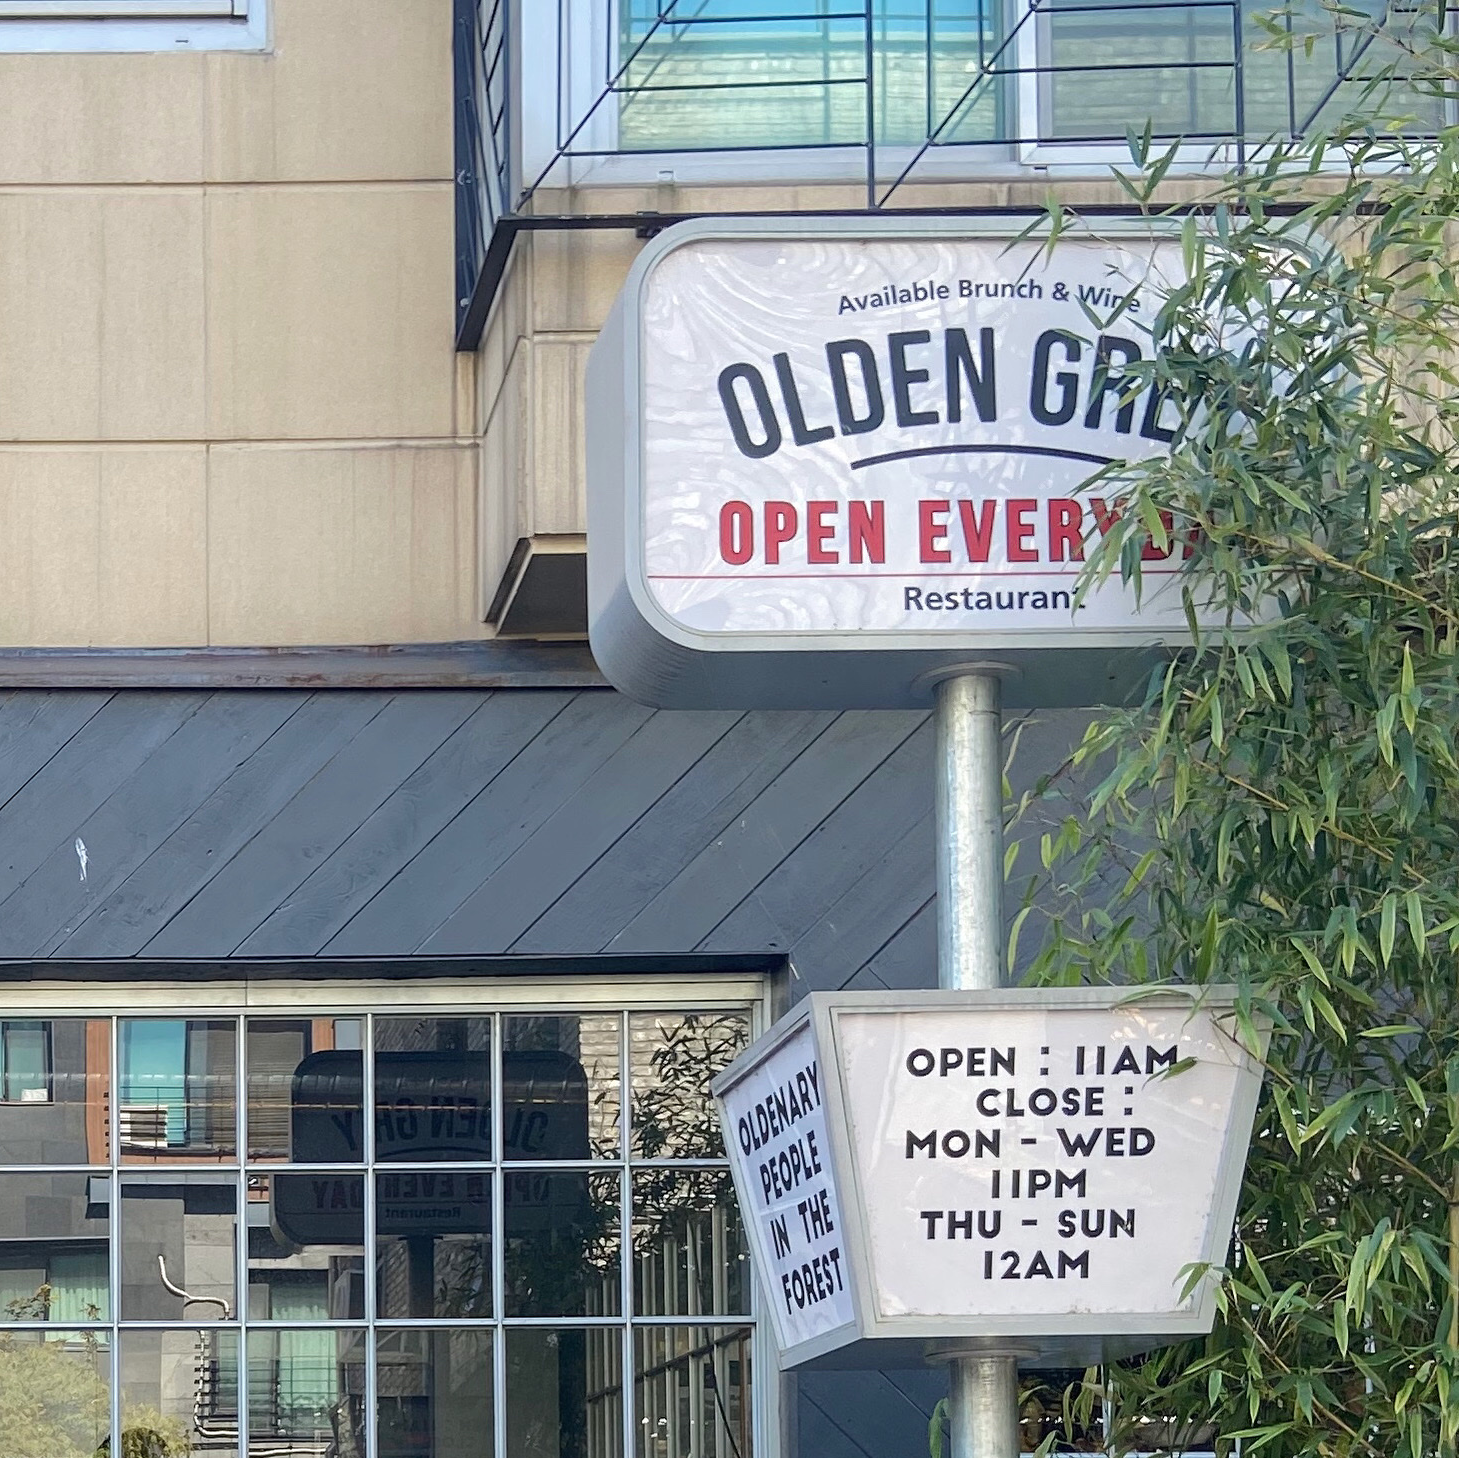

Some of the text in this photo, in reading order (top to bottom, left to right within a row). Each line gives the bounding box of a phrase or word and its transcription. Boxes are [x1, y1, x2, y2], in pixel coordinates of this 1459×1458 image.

[838, 279, 950, 315] Available
[959, 279, 1042, 299] Brunch
[1052, 282, 1069, 302] &
[718, 327, 1182, 459] OLDEN GRE
[719, 498, 1202, 566] OPEN EVERY
[906, 1046, 1016, 1077] OPEN
[1075, 1044, 1180, 1075] 11AM
[738, 1060, 822, 1157] OLDENARY
[976, 1087, 1105, 1117] CLOSE
[905, 1129, 1001, 1159] MON
[1056, 1127, 1157, 1157] WED
[760, 1131, 822, 1206] PEOPLE
[991, 1169, 1087, 1199] 11PM
[770, 1190, 834, 1261] IN THE
[920, 1210, 1002, 1240] THU
[1057, 1208, 1136, 1239] SUN
[782, 1248, 846, 1316] FOREST
[983, 1249, 1090, 1280] 12AM
